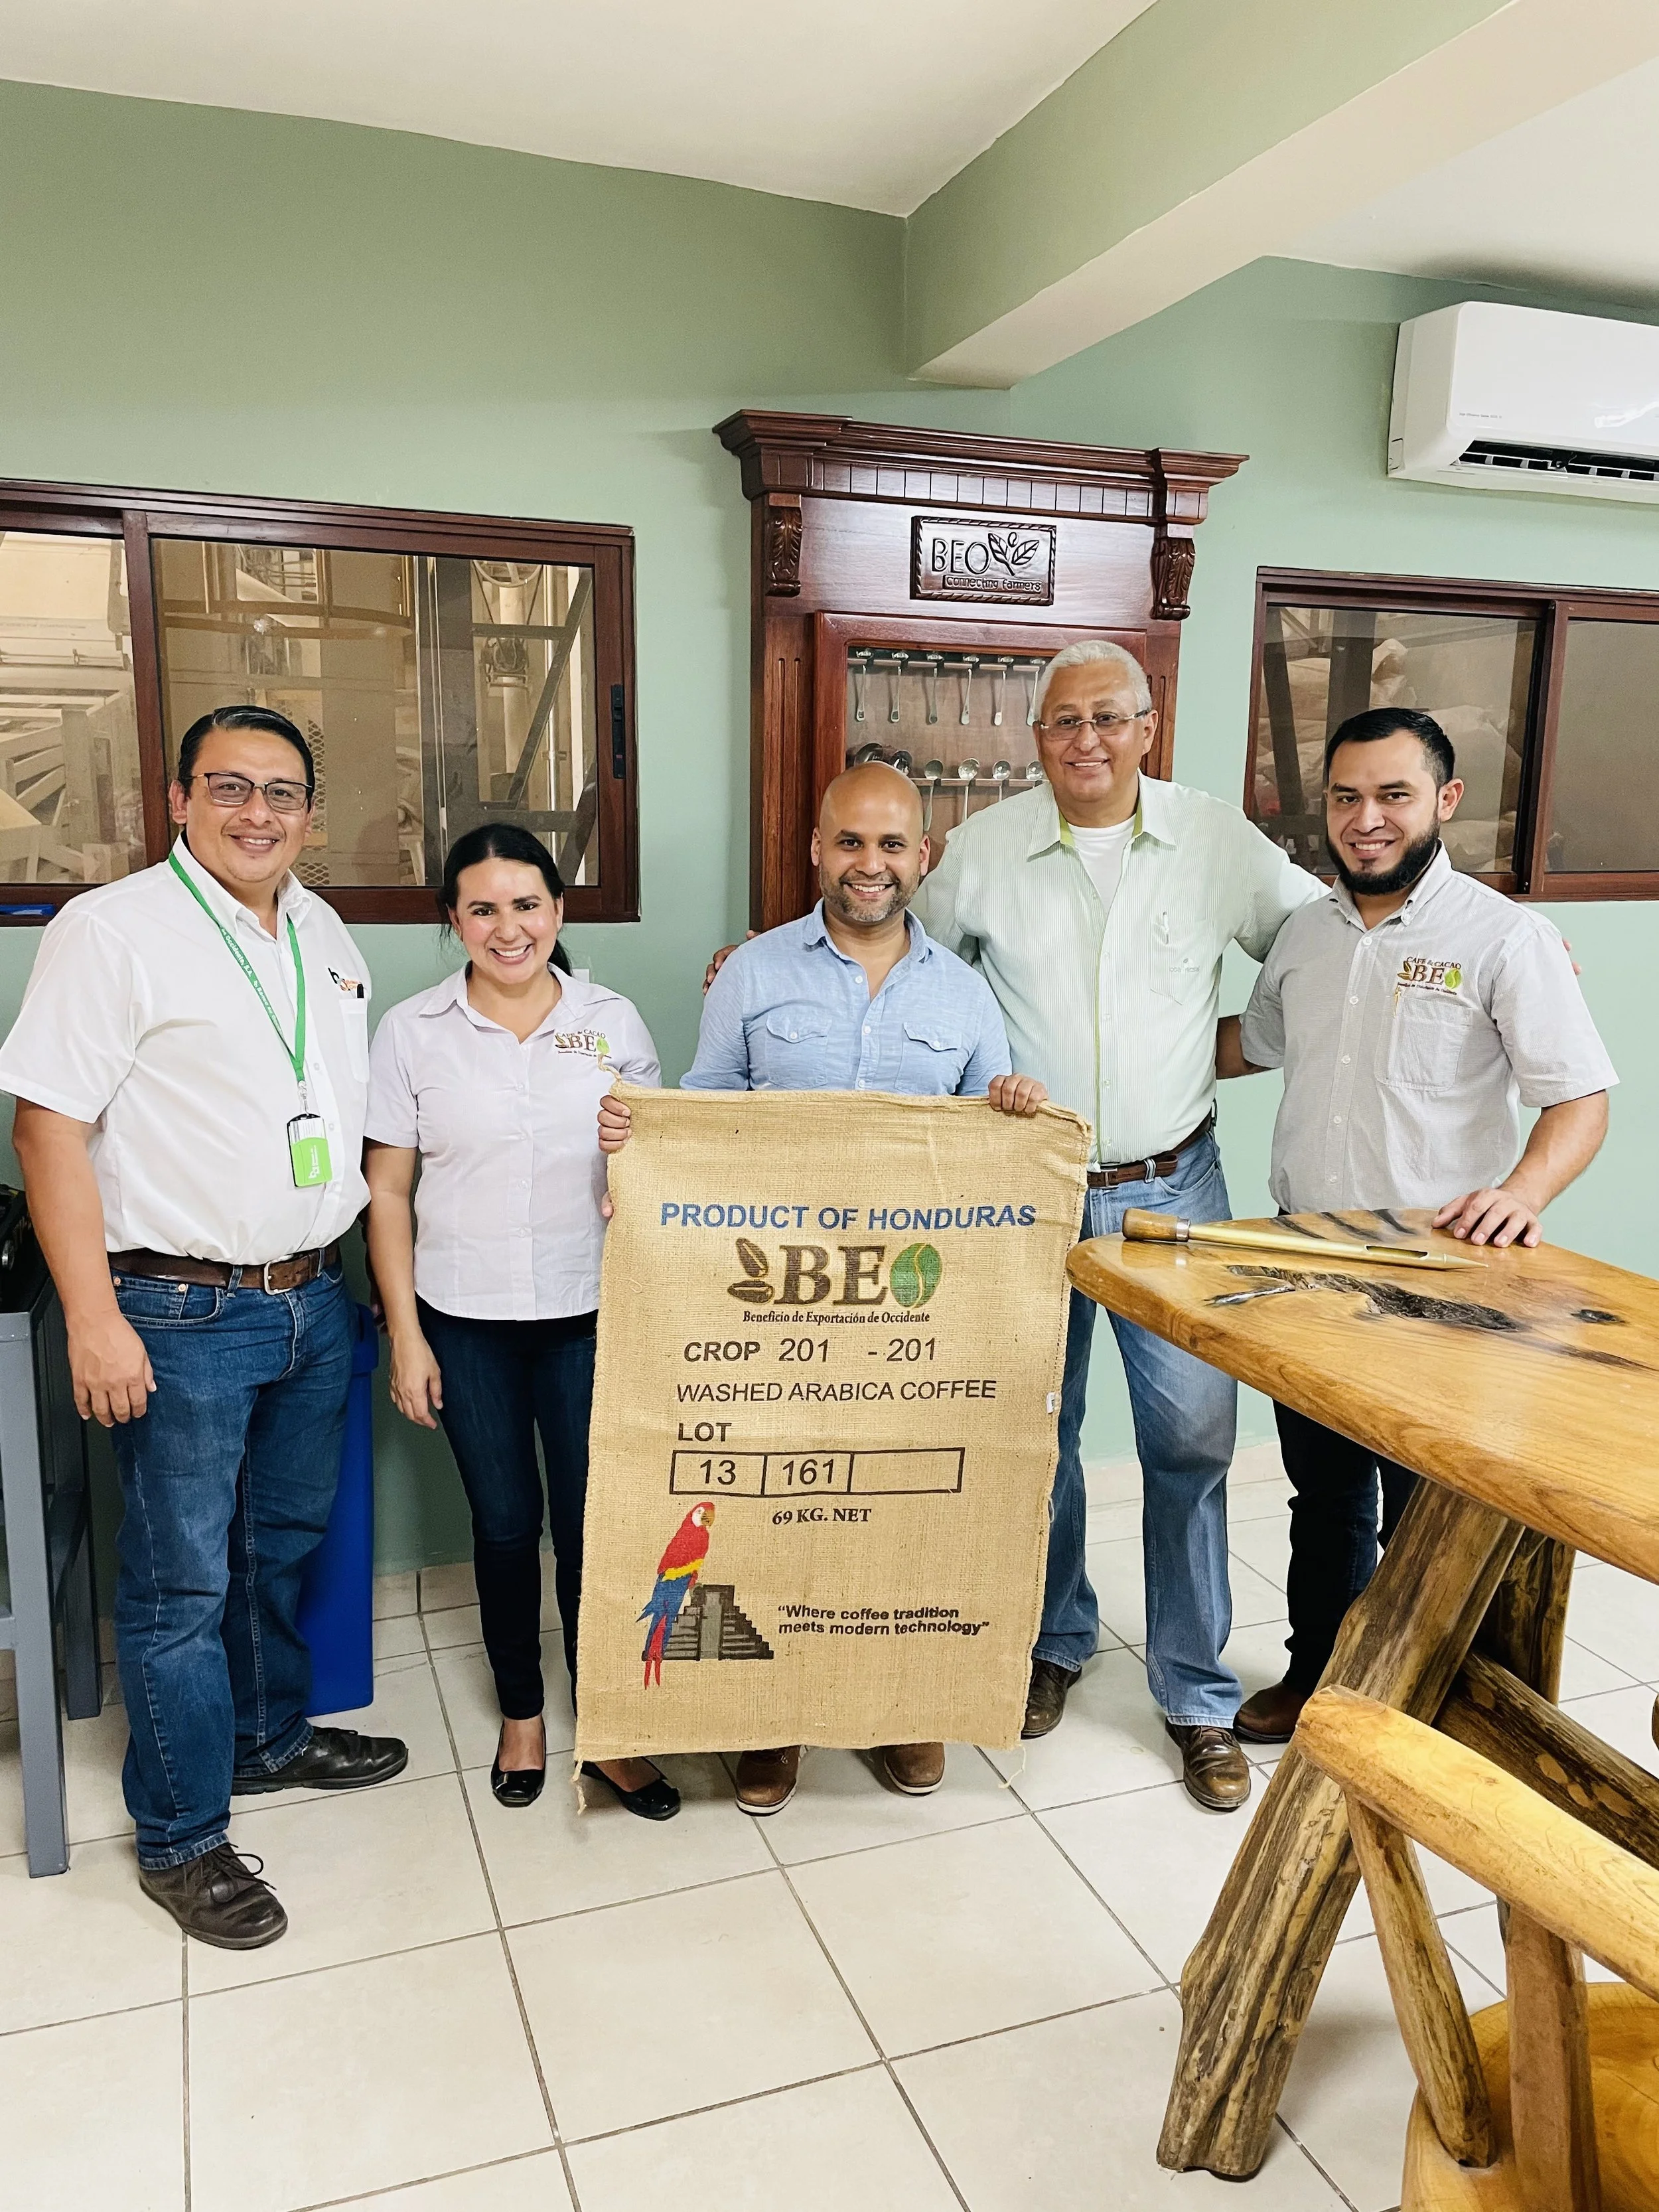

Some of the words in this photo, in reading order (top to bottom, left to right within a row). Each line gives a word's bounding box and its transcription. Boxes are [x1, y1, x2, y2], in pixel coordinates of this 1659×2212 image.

[932, 538, 991, 575] BEO
[1434, 961, 1462, 970] CACAO
[583, 1029, 606, 1039] CACAO
[661, 1203, 809, 1228] PRODUCT
[818, 1207, 859, 1230] OF
[868, 1205, 1037, 1230] HONDURAS
[743, 1311, 789, 1323] Beneficio
[792, 1311, 804, 1323] de
[806, 1311, 865, 1325] Exportación
[867, 1311, 880, 1323] de
[881, 1311, 930, 1323] Occidente
[684, 1341, 760, 1362] CROP
[779, 1338, 828, 1362] 201
[677, 1383, 782, 1402] WASHED
[788, 1382, 894, 1402] ARABICA
[901, 1380, 997, 1400] COFFEE
[678, 1422, 732, 1441] LOT
[700, 1459, 736, 1485] 13
[782, 1459, 833, 1485] 161
[772, 1511, 793, 1525] 69
[796, 1508, 828, 1522] KG.
[833, 1508, 871, 1522] NET
[840, 1607, 889, 1620] coffee
[893, 1606, 959, 1619] tradition
[778, 1622, 825, 1633] meets
[830, 1621, 890, 1635] modern
